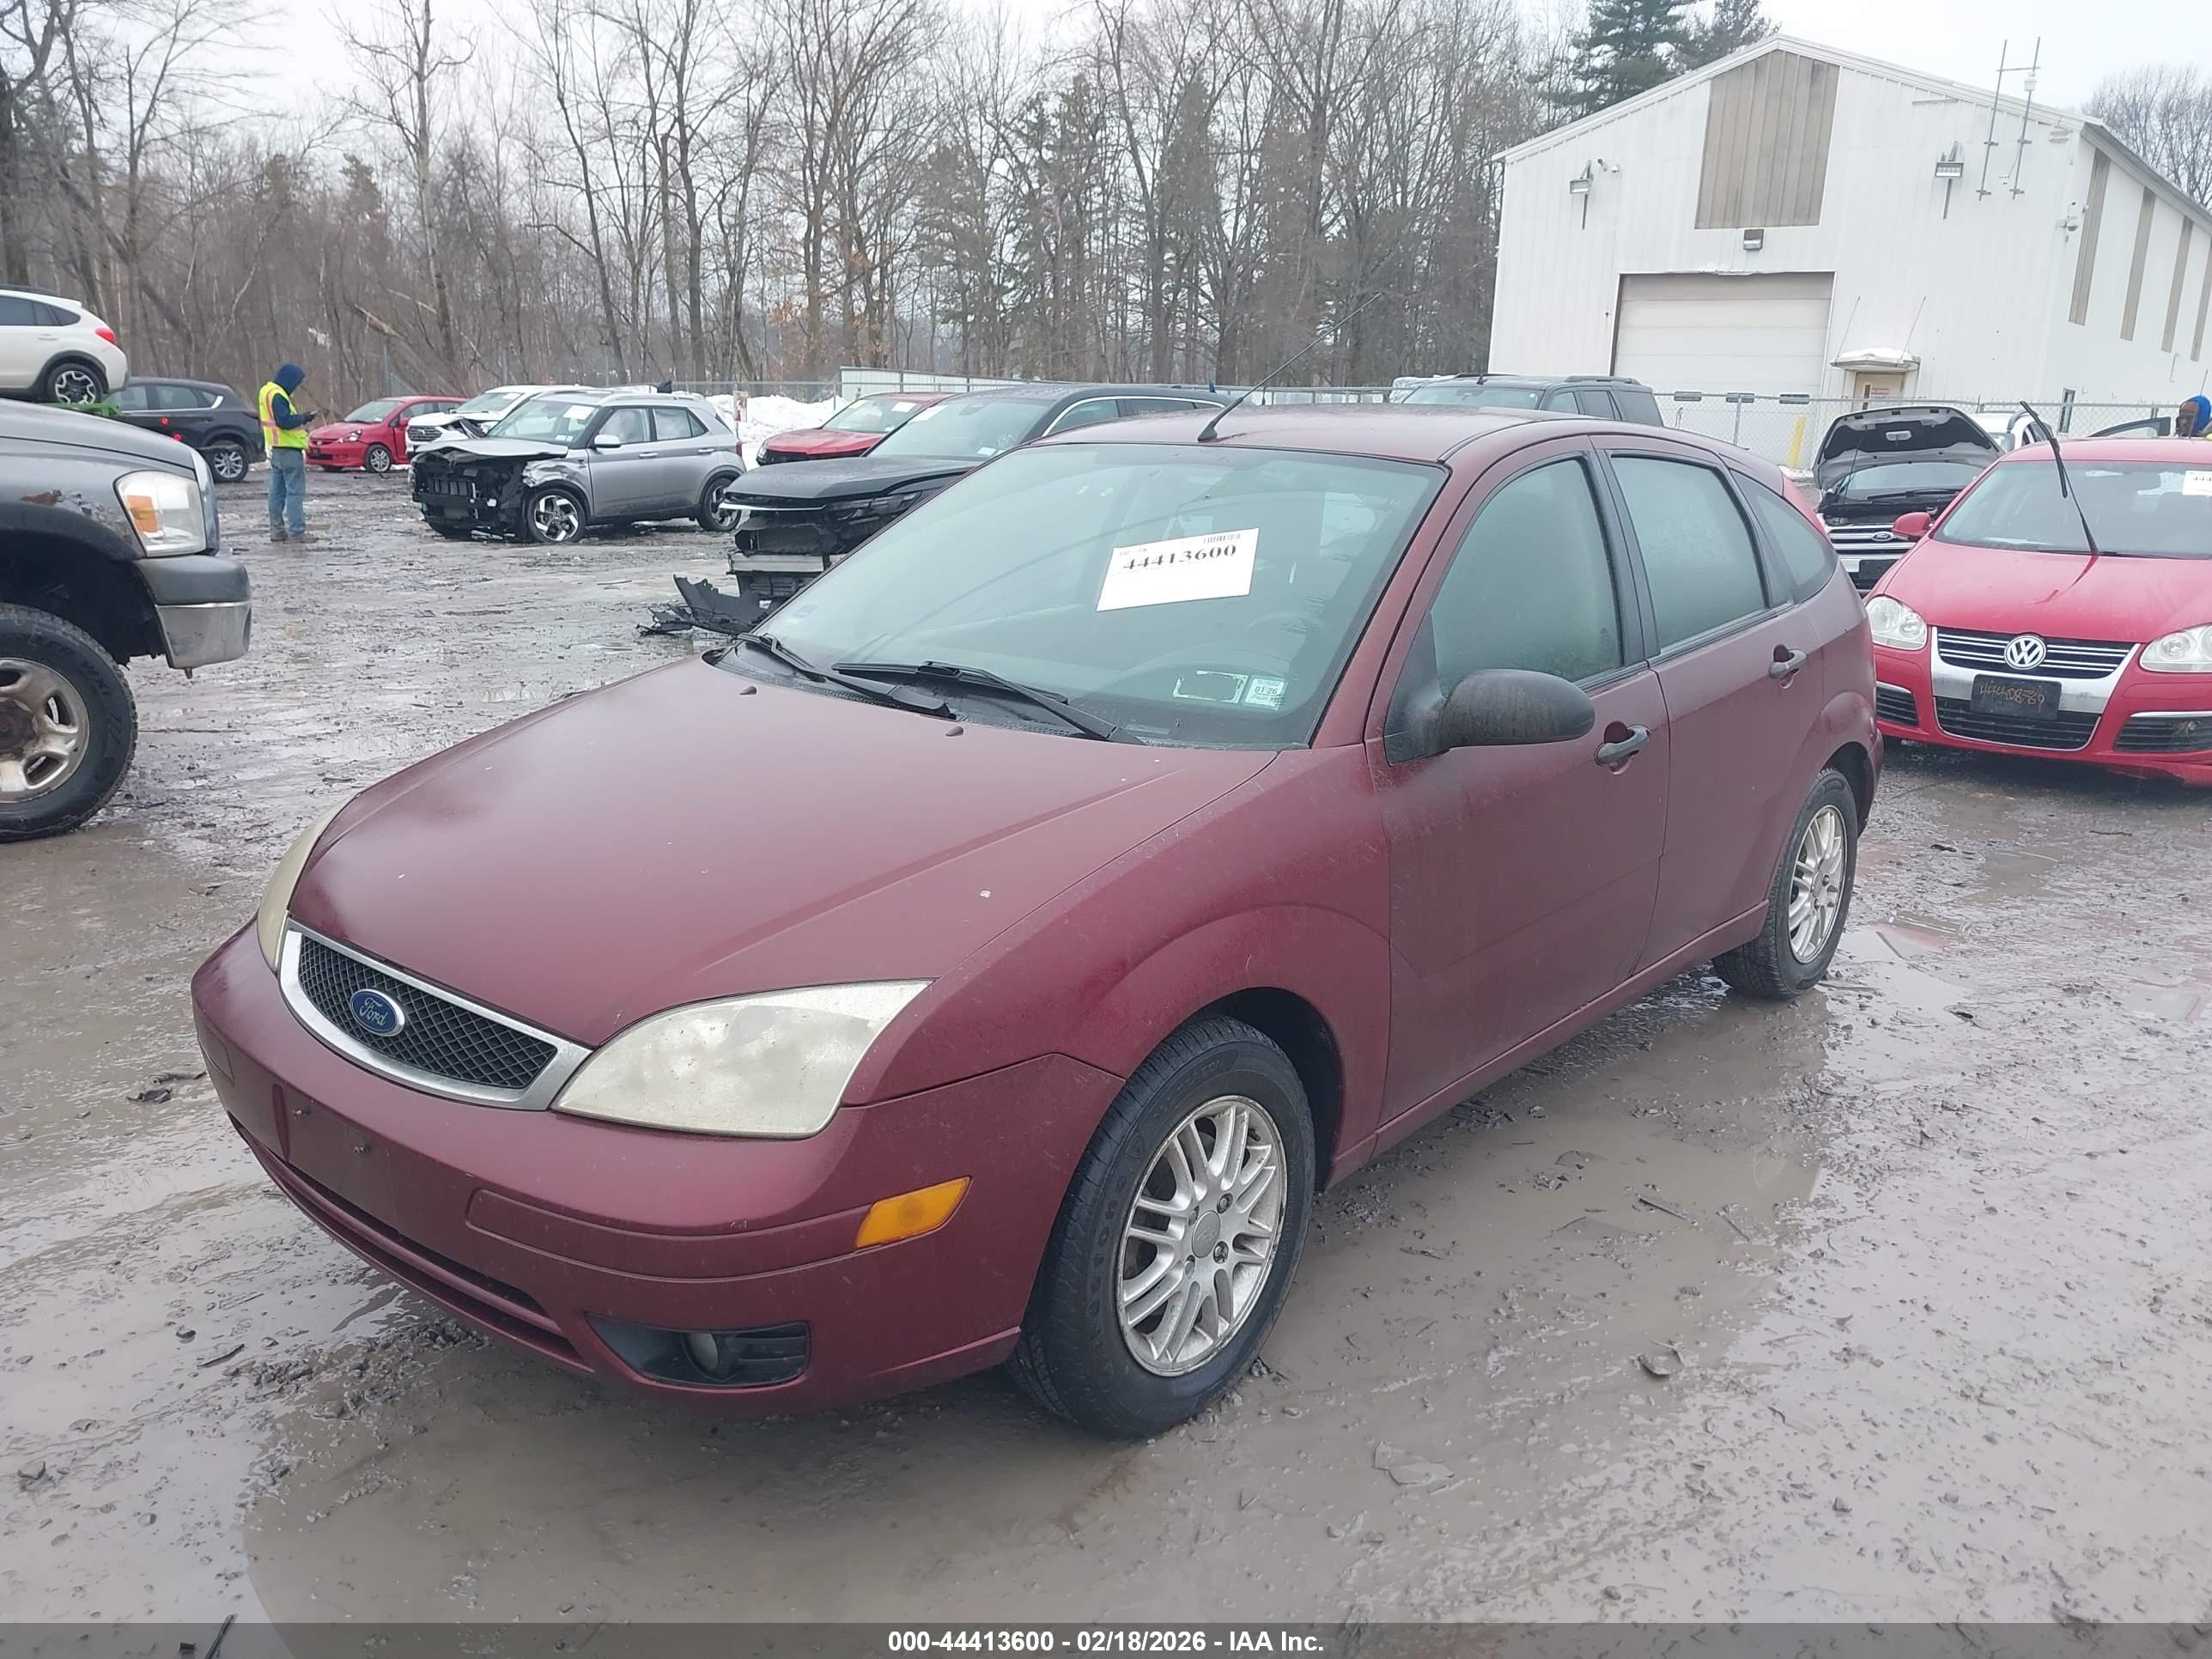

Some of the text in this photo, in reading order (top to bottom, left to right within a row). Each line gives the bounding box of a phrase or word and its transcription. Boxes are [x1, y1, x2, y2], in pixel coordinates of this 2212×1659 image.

[1122, 544, 1237, 570] 44413600
[2006, 637, 2045, 667] VW
[359, 997, 389, 1026] Ford
